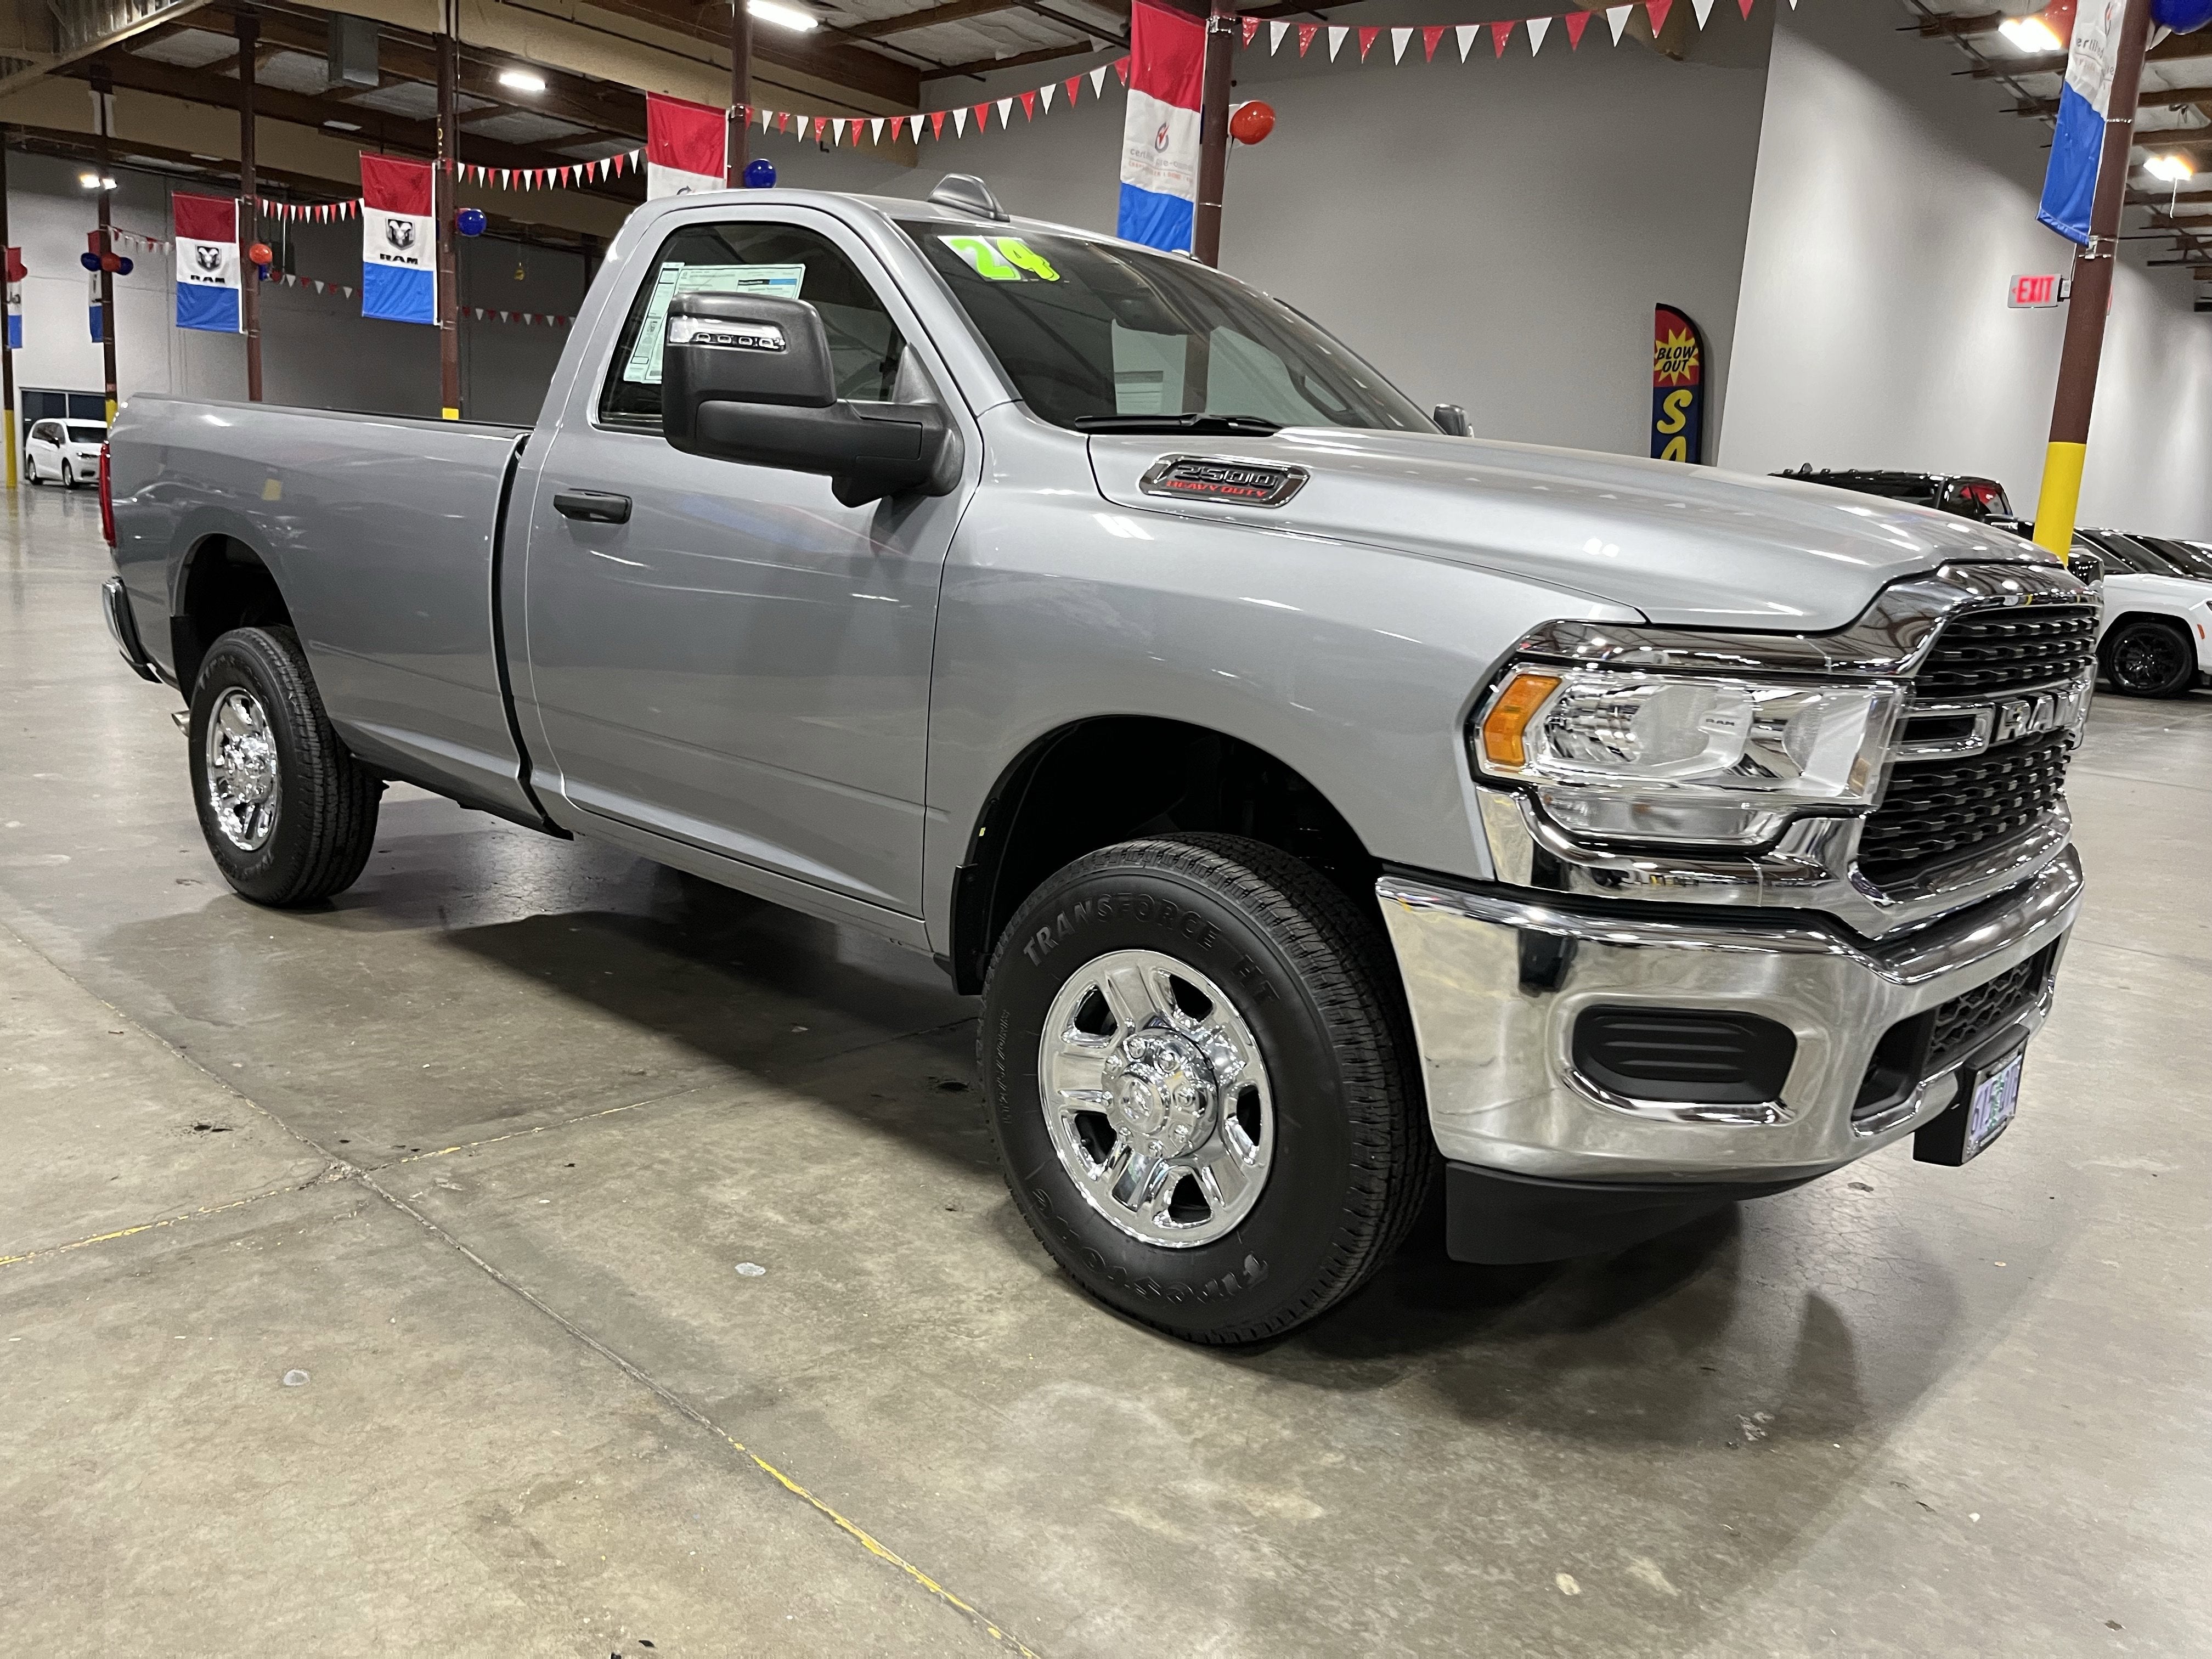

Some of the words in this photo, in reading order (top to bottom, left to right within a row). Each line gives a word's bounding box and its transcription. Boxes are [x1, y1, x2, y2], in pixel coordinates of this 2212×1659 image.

[380, 253, 418, 264] RAM
[950, 237, 1060, 281] 24
[190, 275, 225, 284] RAM
[2016, 275, 2055, 304] EXIT
[1657, 346, 1695, 360] BLOW
[1662, 359, 1690, 373] OUT
[1174, 465, 1278, 489] 2500
[1166, 480, 1217, 492] HEAVY
[1220, 484, 1267, 497] DUTY
[1996, 689, 2082, 742] RAM
[1023, 893, 1221, 967] TRANSFORCE
